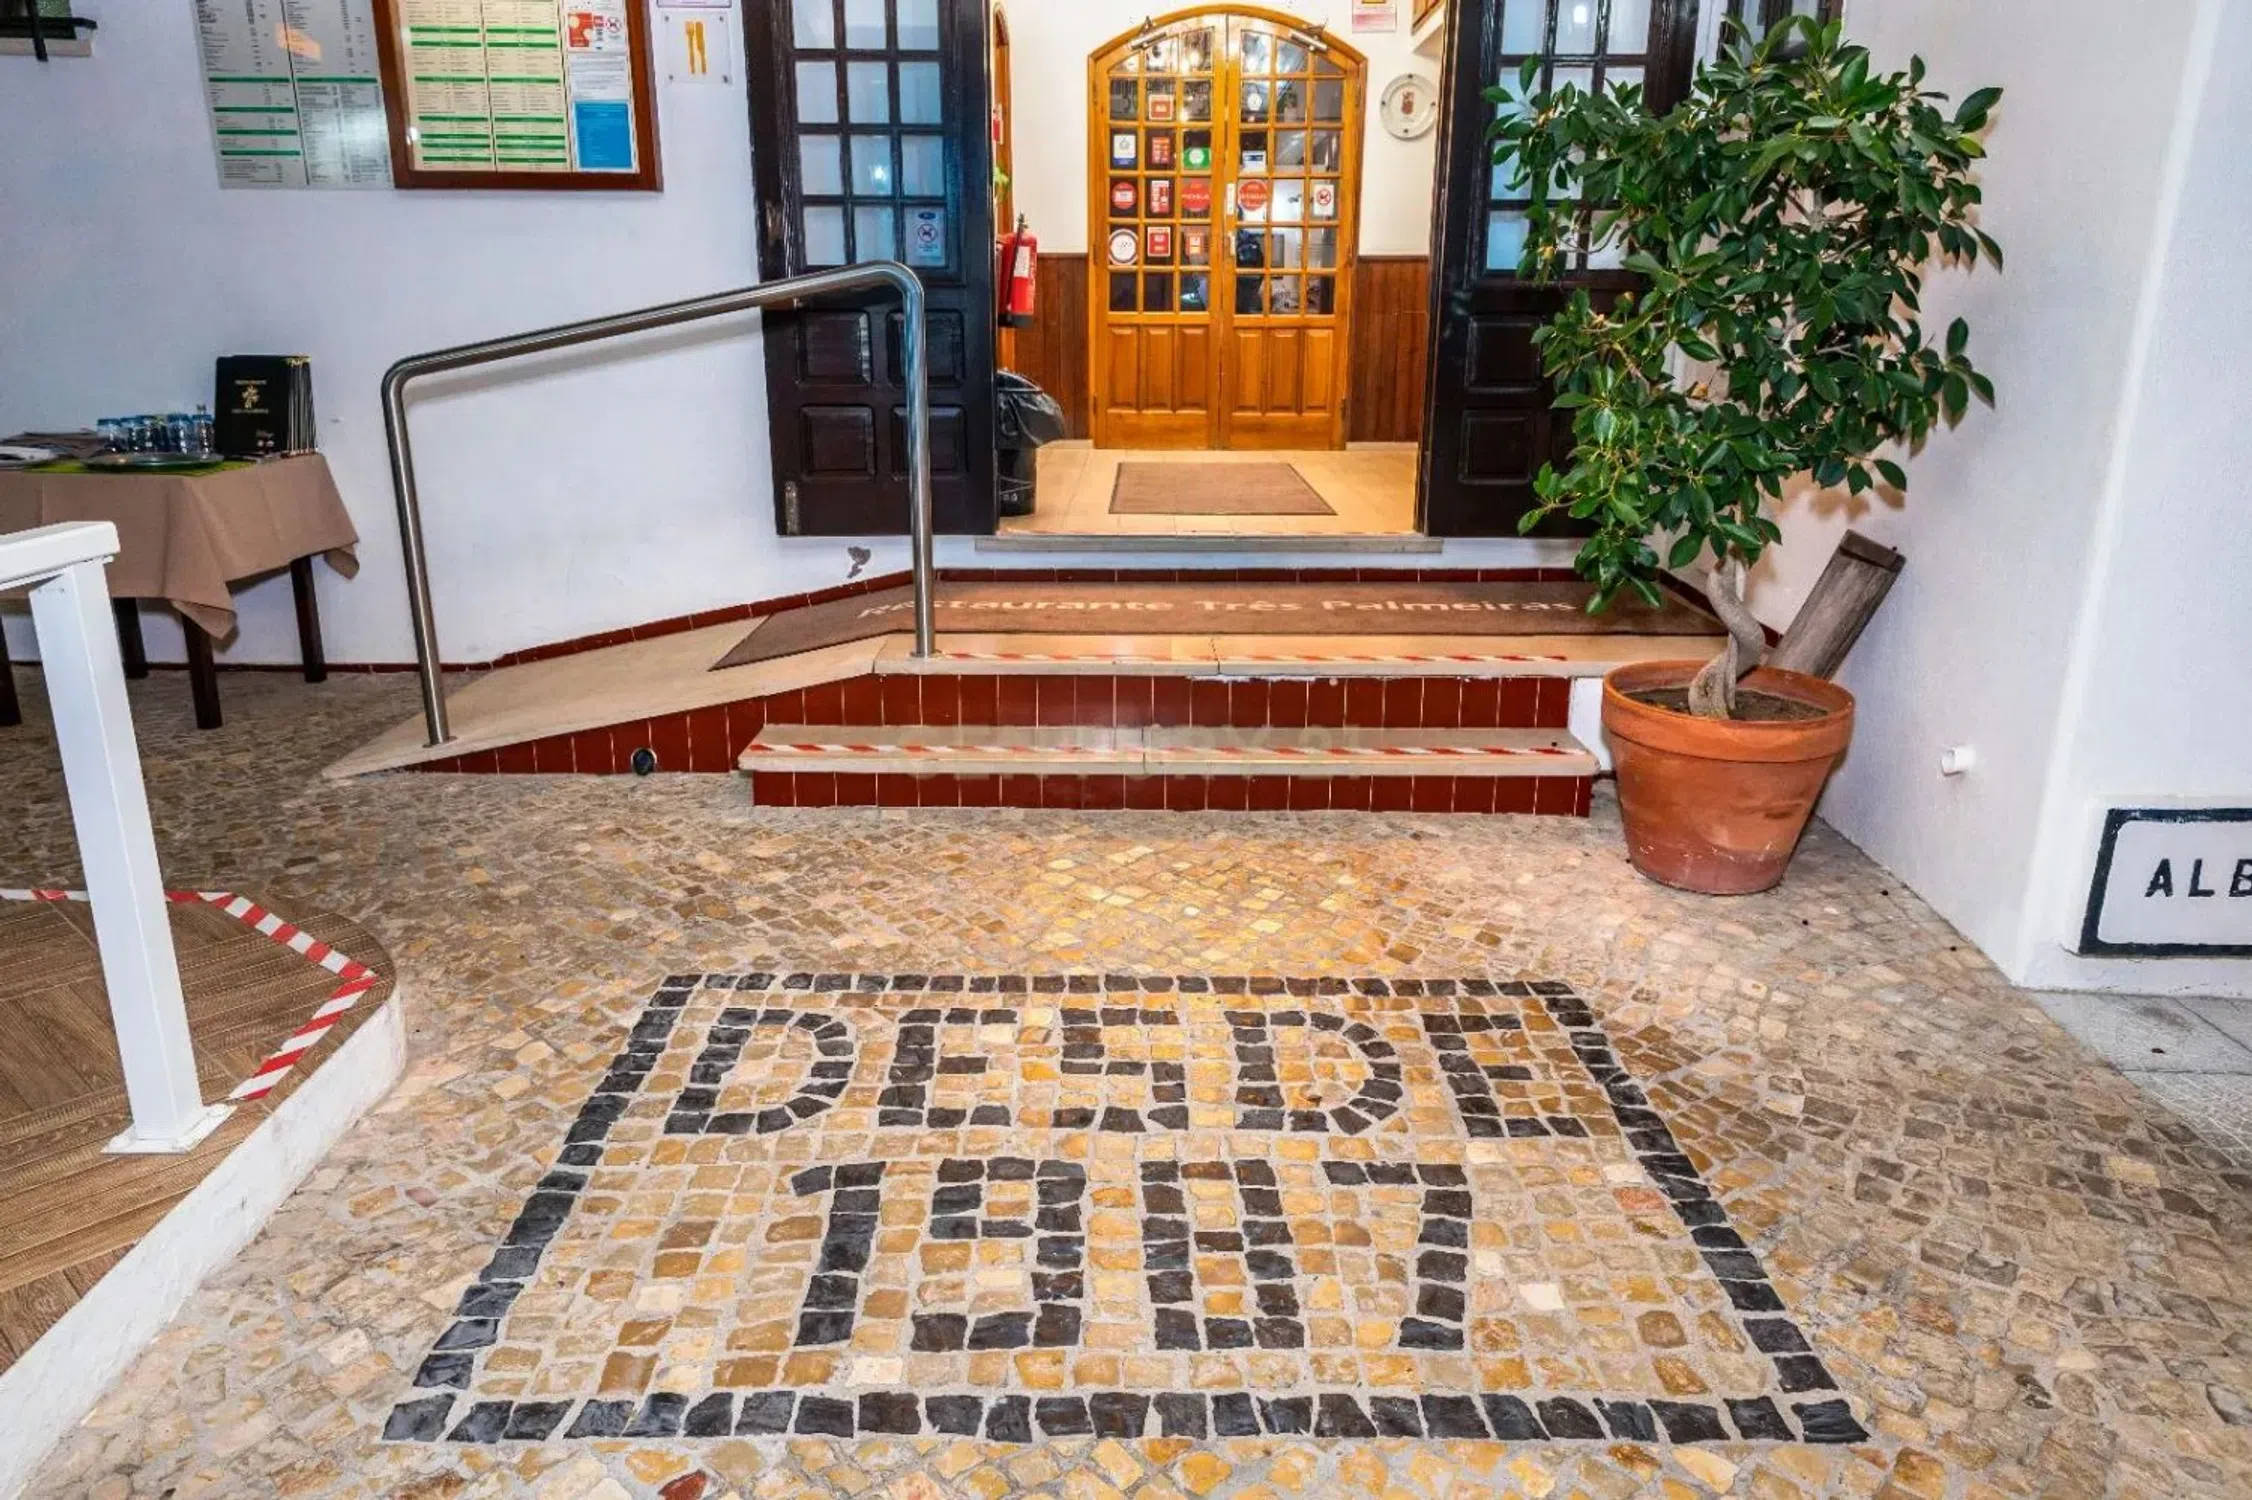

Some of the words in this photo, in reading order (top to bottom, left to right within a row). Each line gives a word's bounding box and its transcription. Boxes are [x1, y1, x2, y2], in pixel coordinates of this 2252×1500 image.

[1320, 600, 1578, 612] Palmeiras
[2144, 858, 2252, 898] ALB
[664, 1006, 1589, 1138] DESDE
